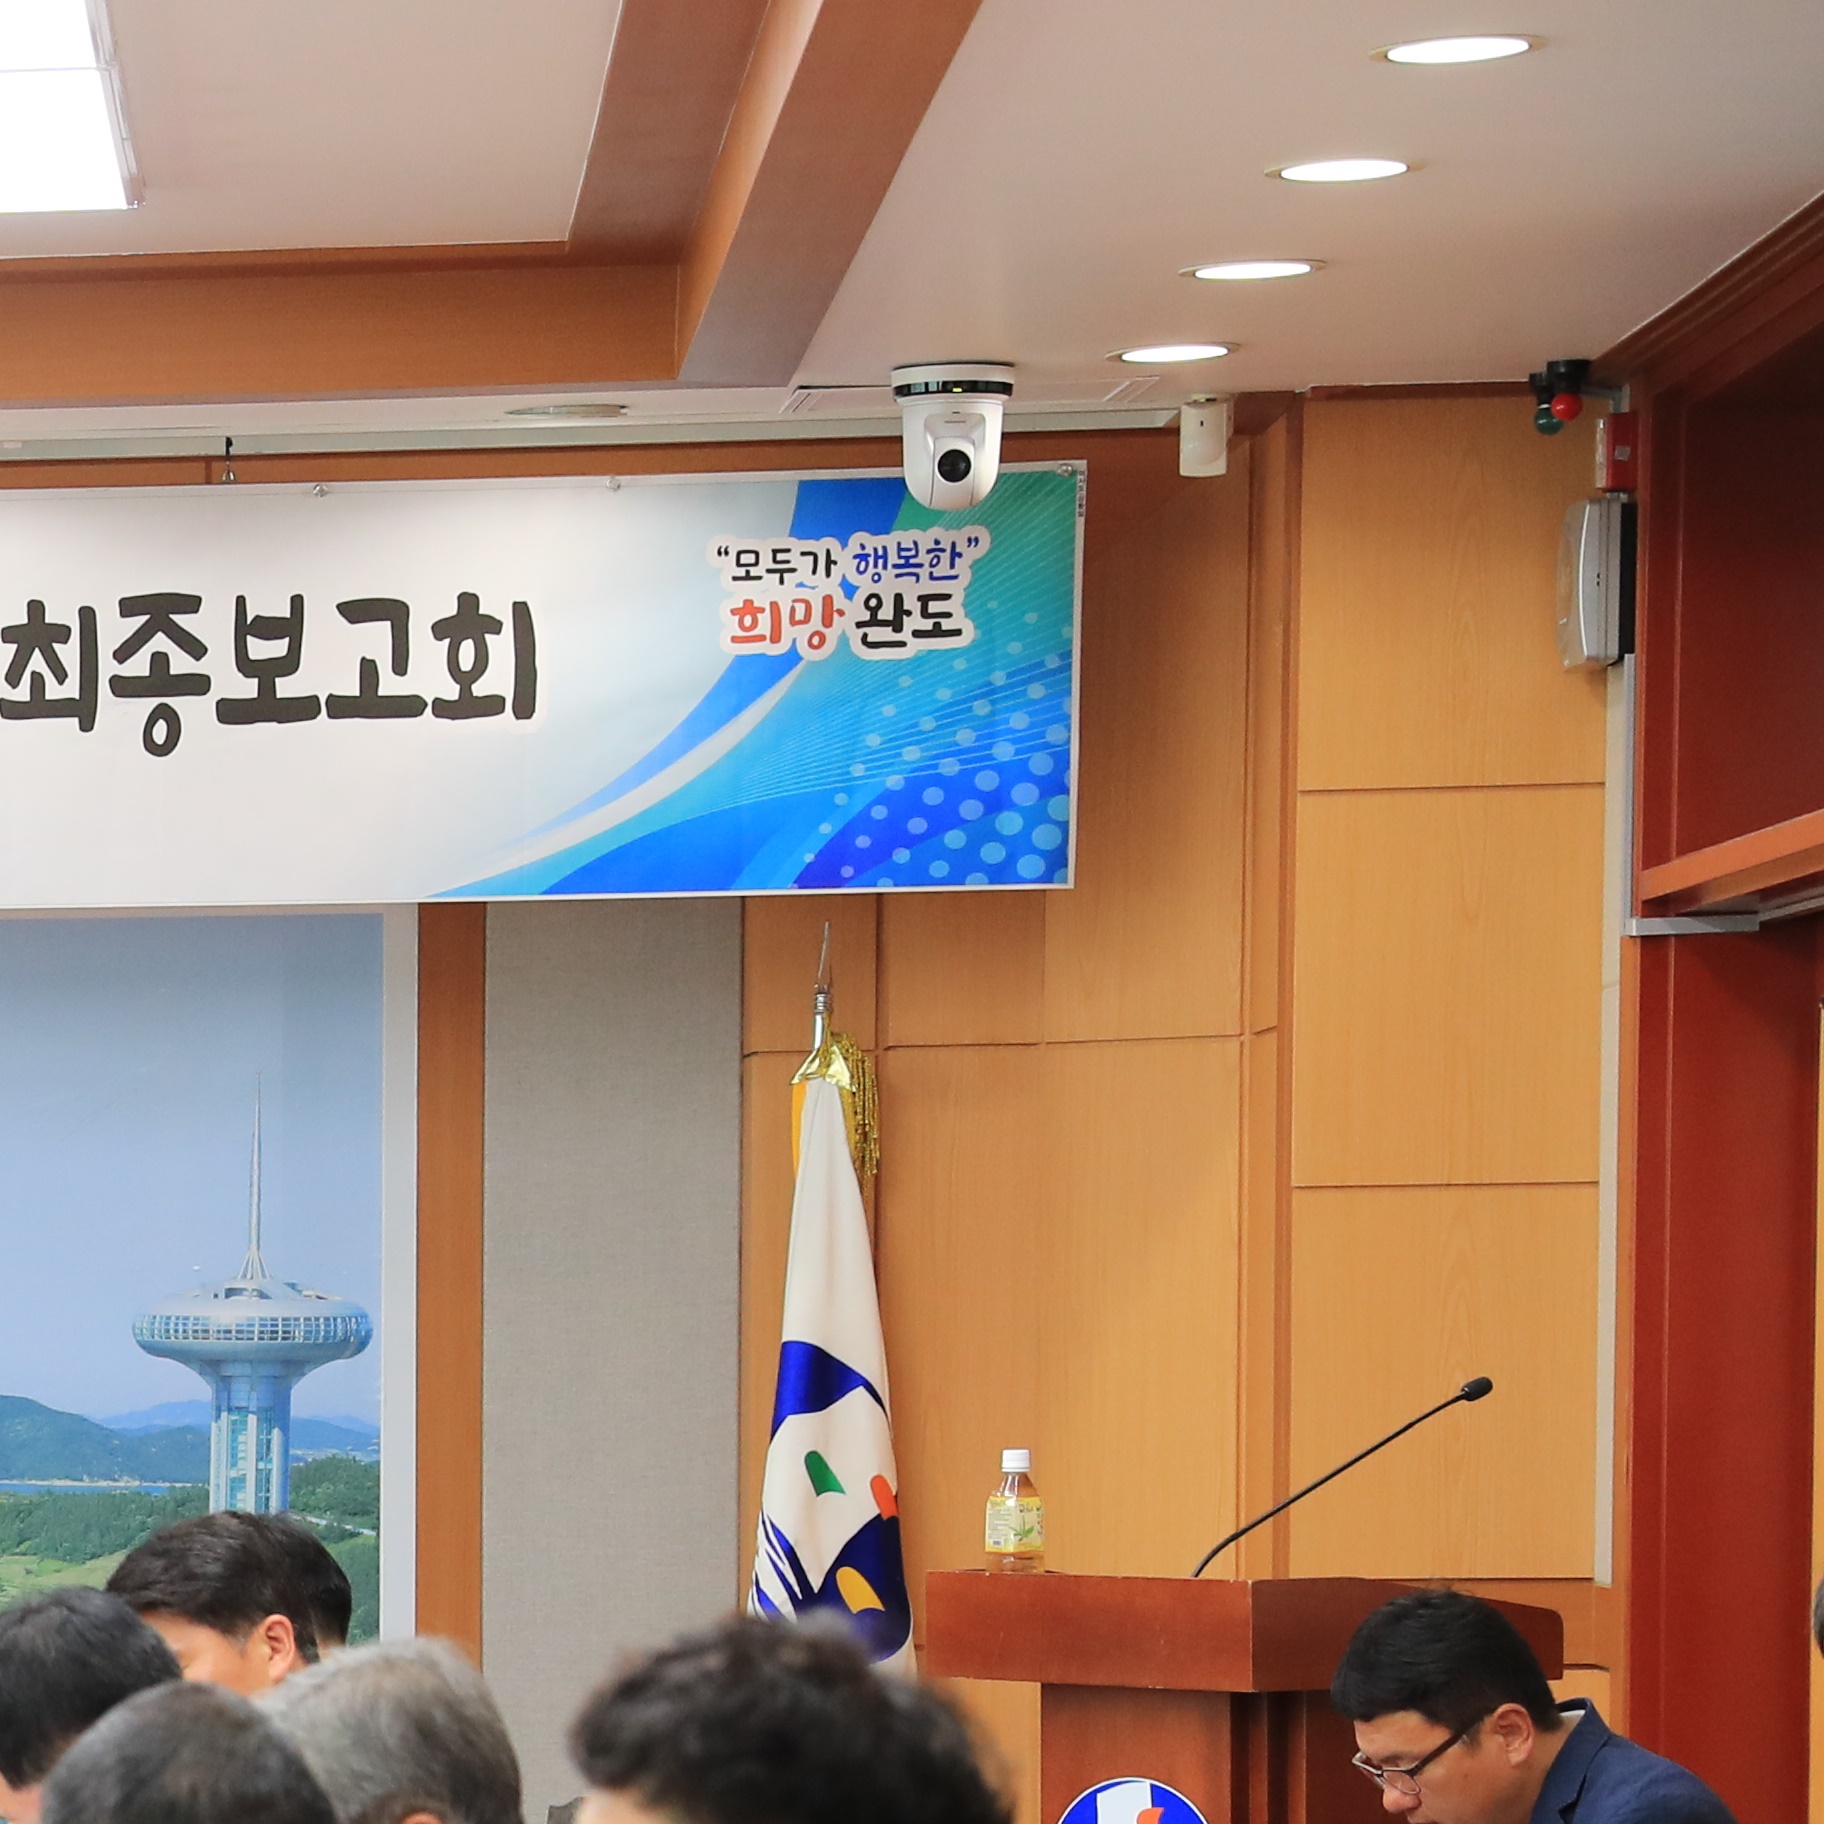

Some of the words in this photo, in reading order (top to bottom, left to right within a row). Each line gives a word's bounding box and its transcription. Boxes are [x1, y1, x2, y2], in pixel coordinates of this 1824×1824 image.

[717, 546, 838, 585] “모두가
[852, 536, 980, 583] 행복한”
[730, 594, 845, 651] 희망
[855, 593, 963, 649] 완도
